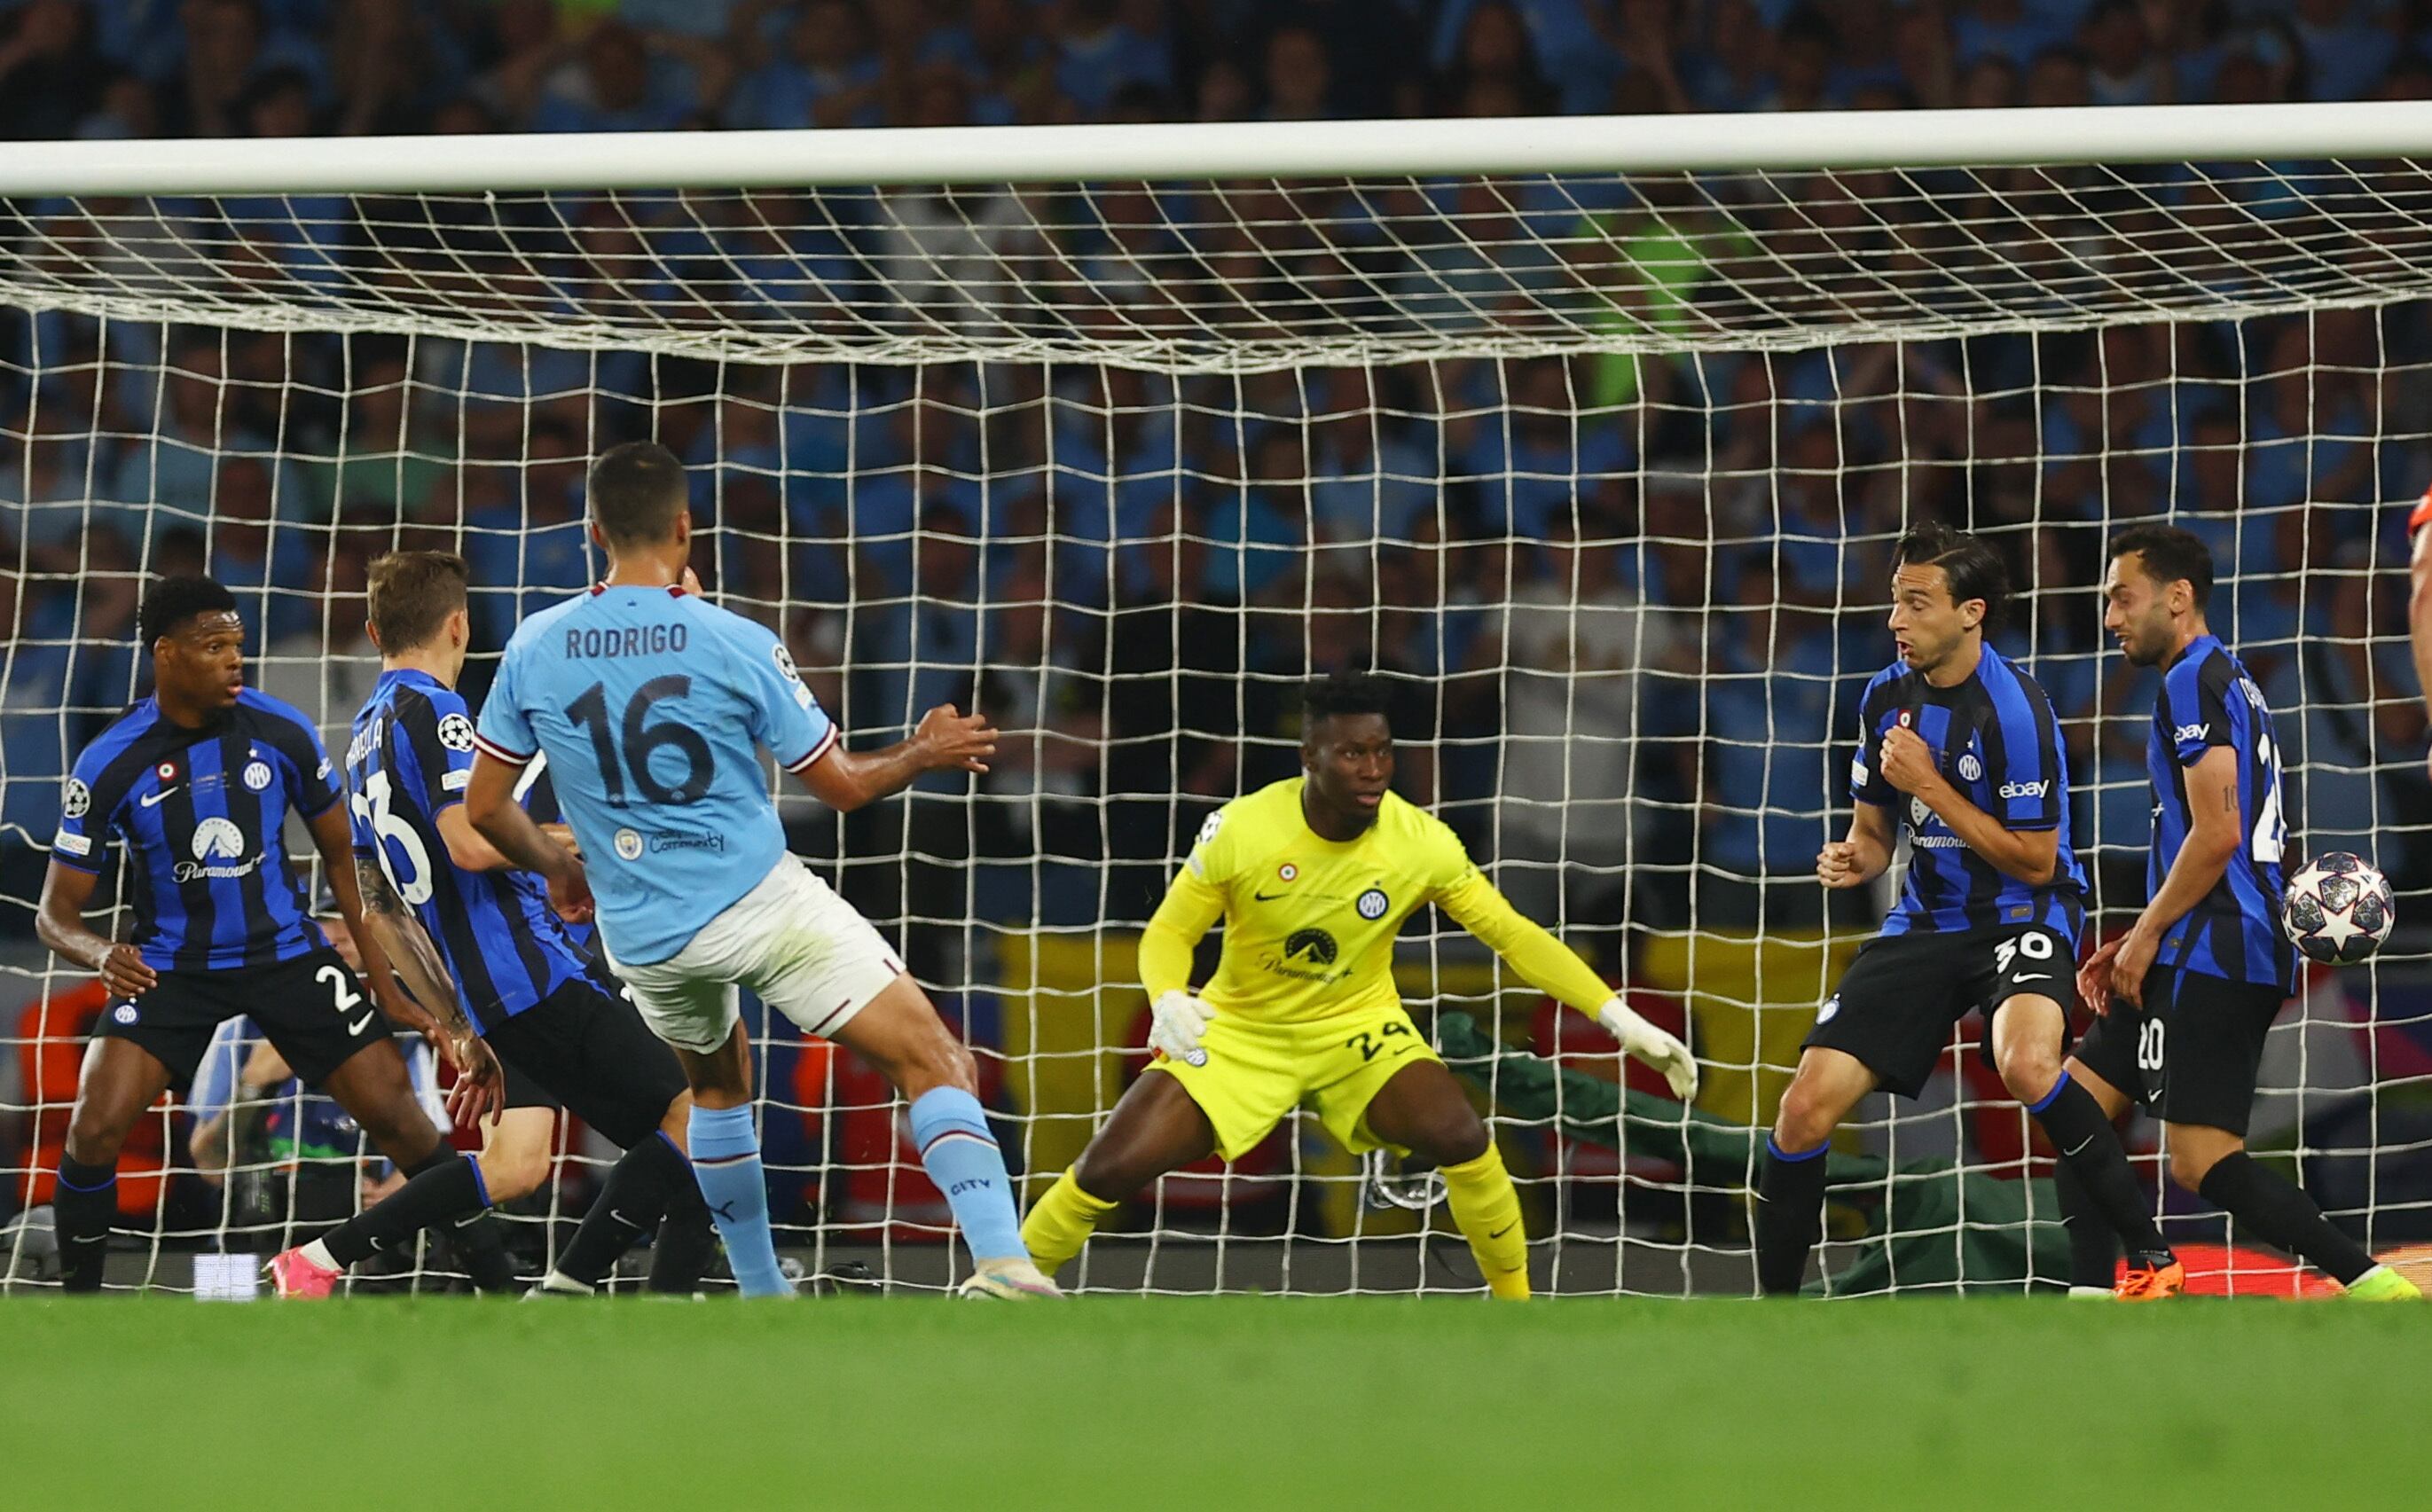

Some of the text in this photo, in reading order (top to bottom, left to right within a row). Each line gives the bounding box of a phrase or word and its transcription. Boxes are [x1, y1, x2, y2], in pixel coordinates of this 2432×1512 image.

[566, 623, 687, 660] RODRIGO
[563, 674, 715, 809] 16
[1999, 780, 2050, 798] ebay
[171, 851, 266, 883] Paramount+
[1994, 931, 2053, 975] 30
[315, 965, 362, 1013] 2
[1346, 1022, 1410, 1062] 24
[2138, 1017, 2164, 1070] 20
[950, 1179, 991, 1195] CITY
